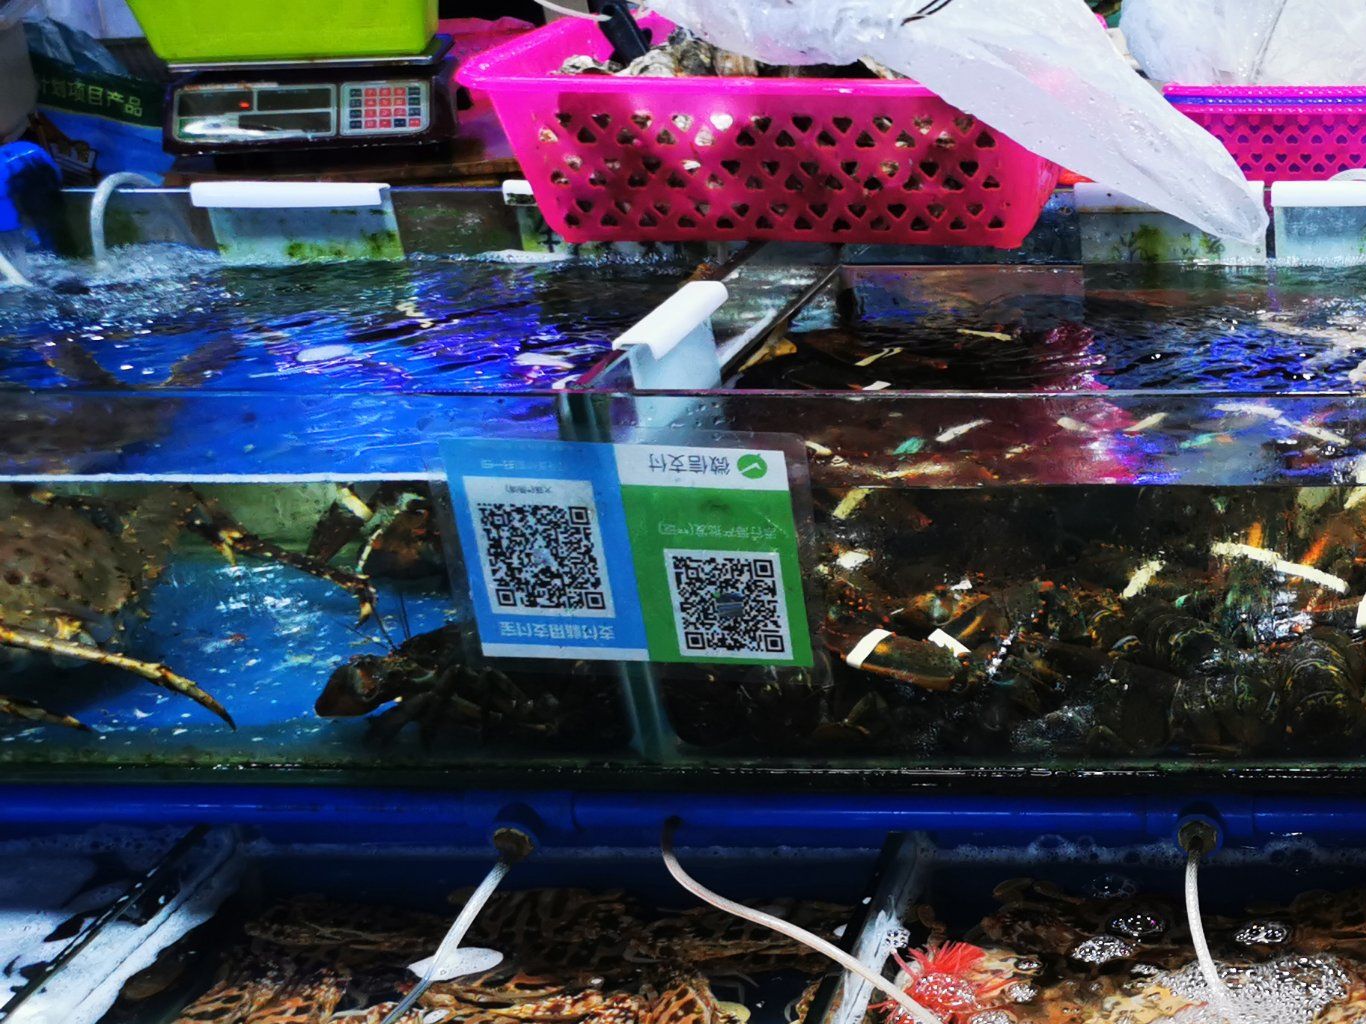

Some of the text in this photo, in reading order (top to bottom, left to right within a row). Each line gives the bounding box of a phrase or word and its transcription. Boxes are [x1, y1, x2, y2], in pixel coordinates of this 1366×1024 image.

[649, 453, 730, 476] 微信支付
[500, 621, 615, 641] 支付就用支付宝
